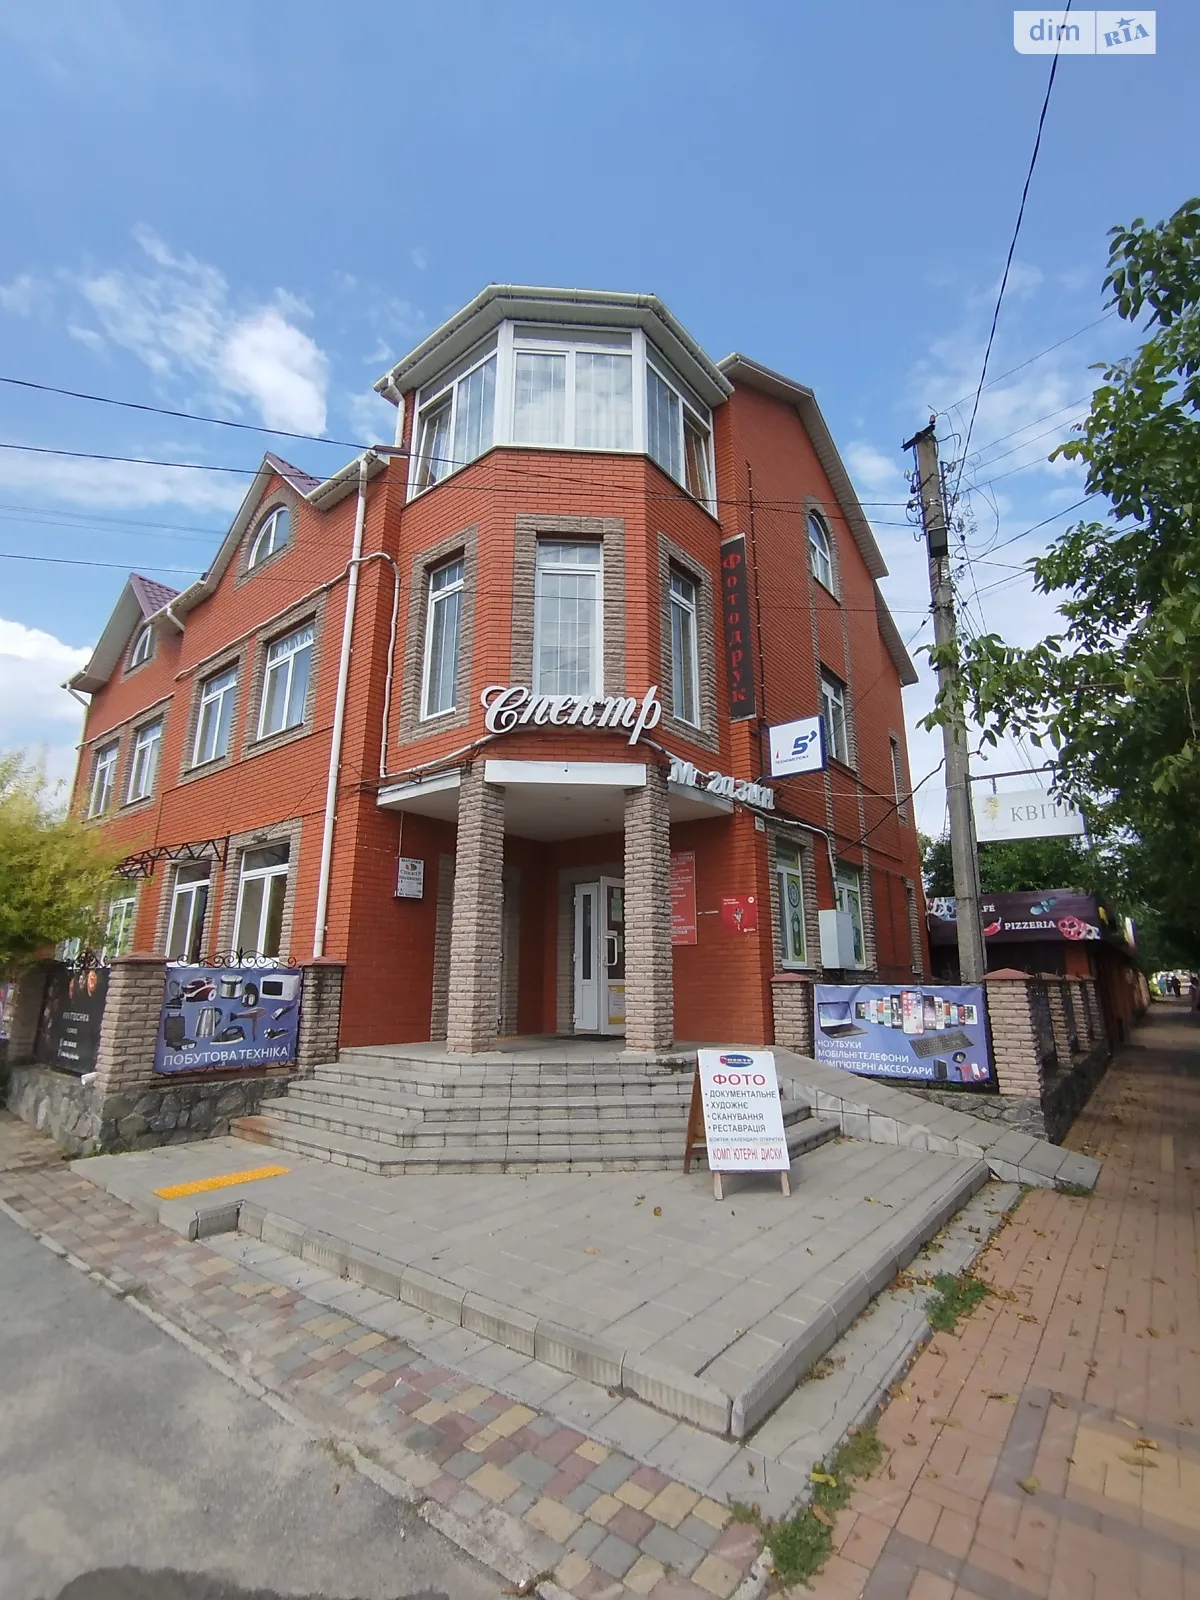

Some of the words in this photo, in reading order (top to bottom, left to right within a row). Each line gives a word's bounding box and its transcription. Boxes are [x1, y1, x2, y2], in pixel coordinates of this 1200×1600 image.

[721, 551, 748, 704] Фотодрук
[480, 684, 662, 746] Спектр
[667, 757, 775, 810] Мгазин
[1004, 920, 1057, 931] PIZZERIA
[817, 1040, 862, 1049] НОУТБУКИ
[163, 1051, 238, 1067] ПОБУТОВА
[240, 1046, 289, 1061] ТЕХНІКА
[818, 1049, 858, 1059] МОБІЛЬНІ
[858, 1051, 909, 1063] ТЕЛЕФОНИ
[878, 1063, 933, 1076] АКСЕСУАРИ
[713, 1073, 766, 1086] ФОТО
[709, 1090, 776, 1099] ДОКУМЕНТАЛЬНЕ
[710, 1101, 749, 1110] ХУДОЖНЄ
[711, 1112, 764, 1121] СКАНУВАННЯ
[712, 1124, 766, 1133] РЕСТАВРАЦІЯ
[761, 1147, 783, 1162] ДИСКИ
